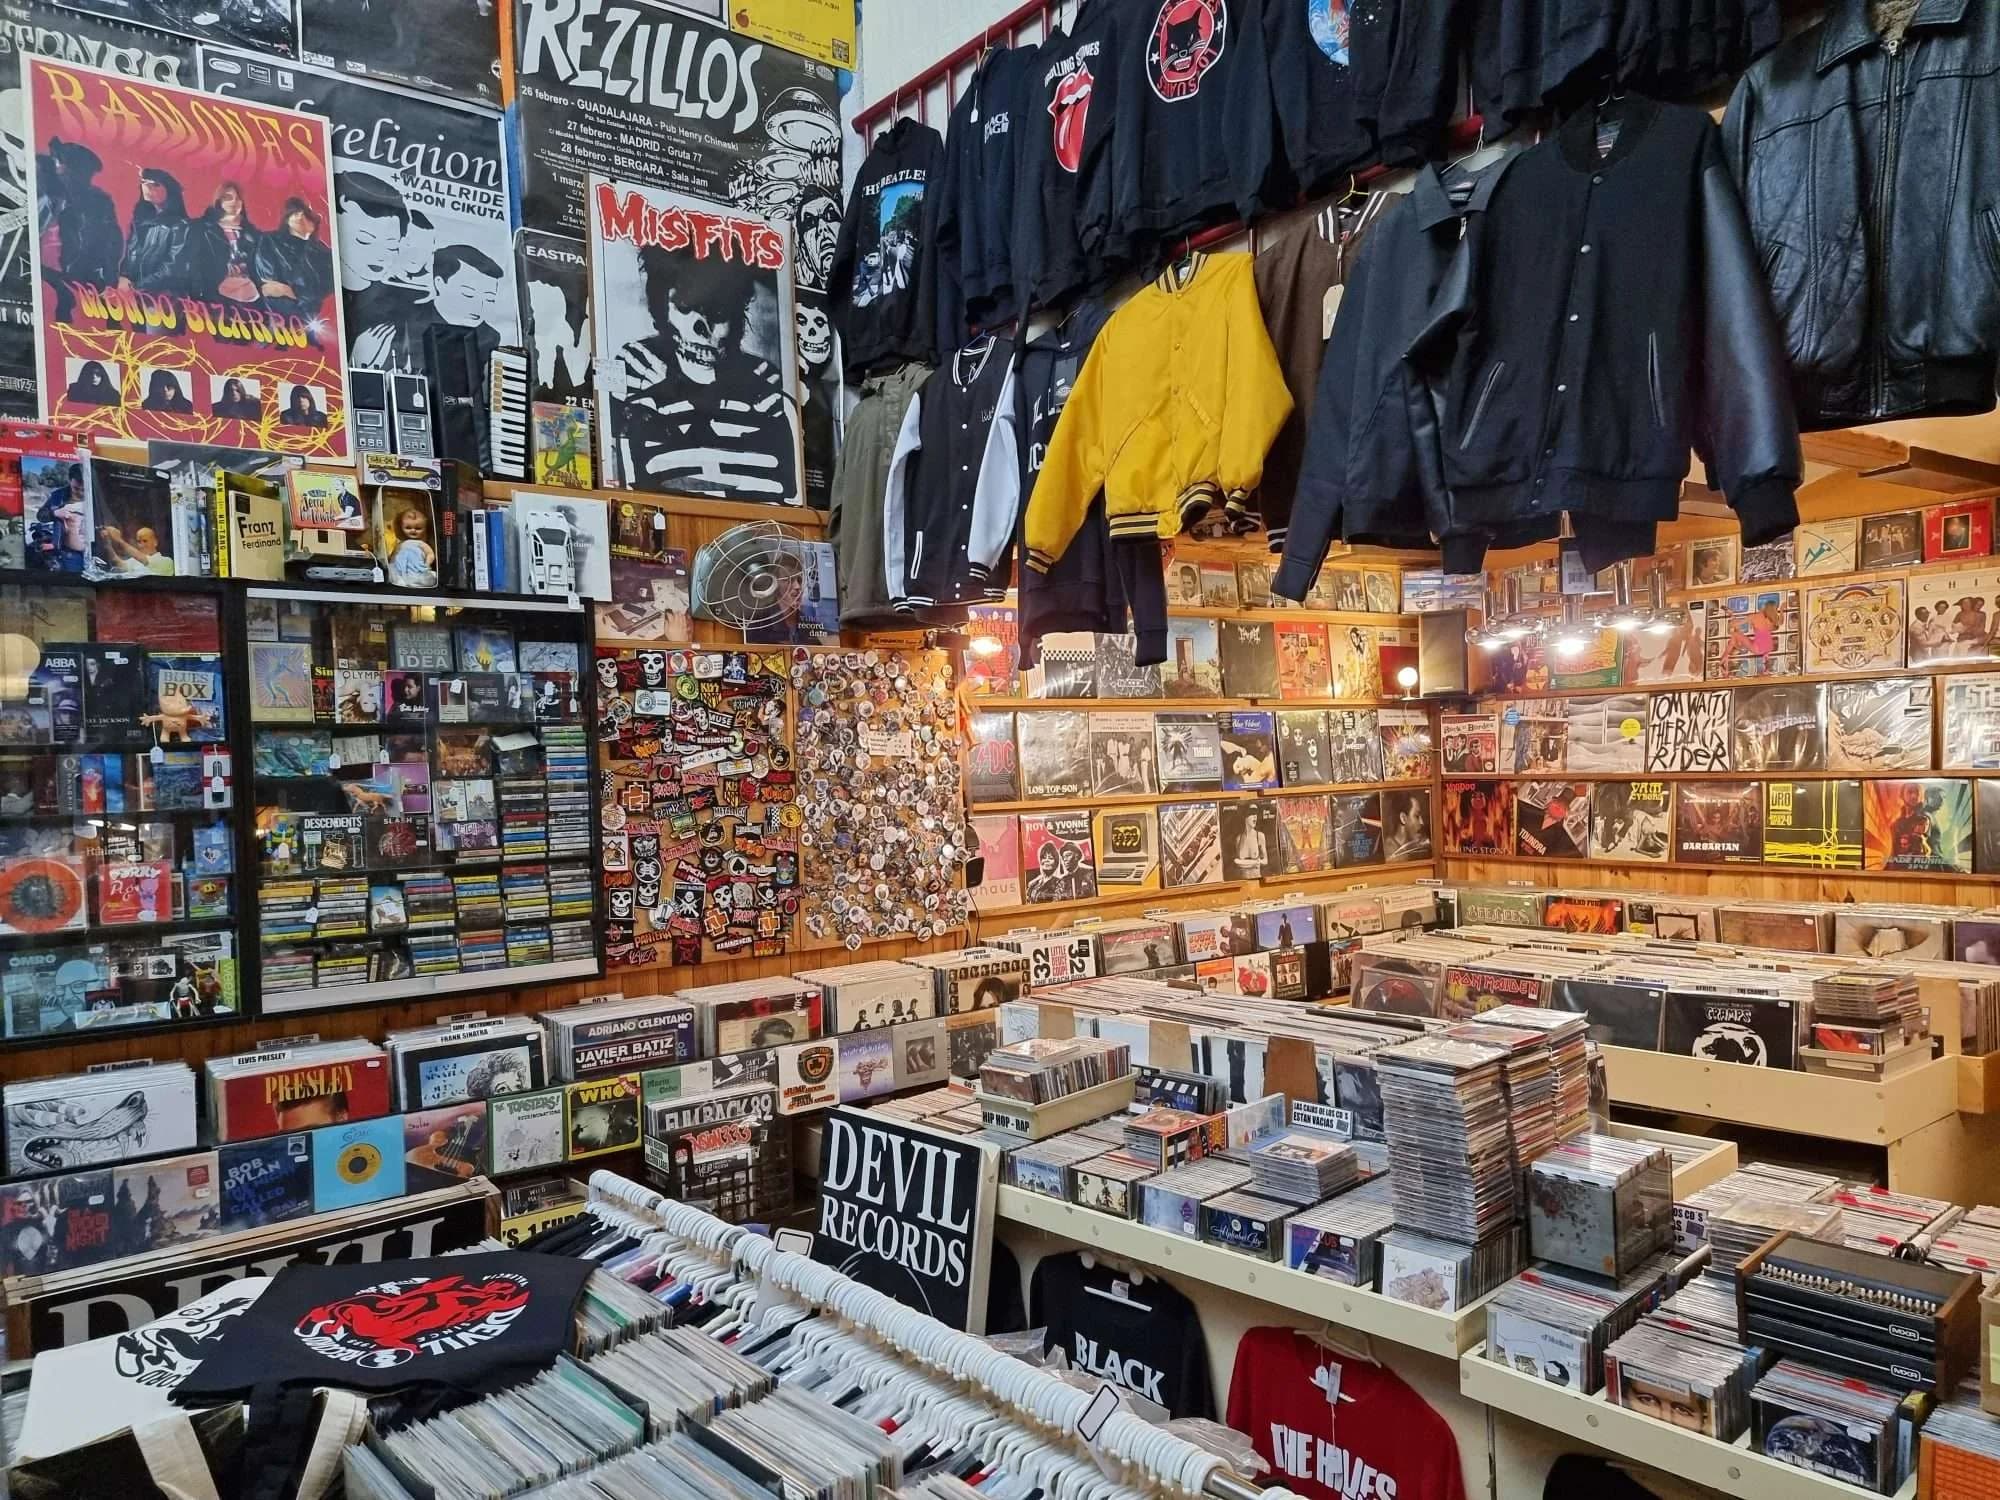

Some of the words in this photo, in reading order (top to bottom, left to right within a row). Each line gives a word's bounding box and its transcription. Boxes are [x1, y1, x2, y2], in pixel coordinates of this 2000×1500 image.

[522, 0, 763, 134] REZILLOS
[521, 85, 534, 96] 26
[535, 88, 569, 106] febrero
[576, 98, 653, 127] GUADALAJARA
[660, 121, 677, 134] Pub
[678, 125, 703, 144] Henry
[40, 66, 326, 185] RAMONES
[567, 120, 578, 131] 27
[579, 123, 612, 141] febrero
[619, 133, 661, 153] MADRID
[667, 146, 692, 161] Gruta
[692, 153, 703, 163] 77
[560, 142, 573, 154] 28
[574, 145, 607, 162] febrero
[614, 155, 665, 177] BERGARA
[671, 170, 690, 184] Sala
[690, 175, 709, 188] Jam
[450, 201, 506, 222] CIKUTA
[595, 182, 785, 271] MISFITS
[525, 245, 586, 266] EASTPA
[182, 297, 310, 349] BIZARRO
[238, 517, 276, 538] Franz
[242, 537, 282, 550] Ferdinand
[798, 622, 825, 630] record
[808, 629, 828, 638] date
[45, 657, 77, 668] ABBA
[400, 656, 449, 669] IDEA
[163, 682, 208, 699] BOX
[1650, 694, 1684, 720] TOM
[1687, 691, 1729, 719] WAITS
[709, 714, 733, 727] MUSE
[1650, 723, 1672, 746] THE
[1028, 785, 1044, 794] LOS
[304, 816, 363, 829] DESCENDENTS
[1026, 821, 1046, 832] ROY
[1055, 819, 1089, 830] YVONNE
[1682, 842, 1740, 852] BARBARIAN
[1465, 904, 1496, 923] BEE
[1497, 906, 1530, 925] GEES
[1447, 969, 1482, 991] IRON
[1483, 969, 1541, 995] MAIDEN
[587, 1021, 636, 1038] ADRIANO
[637, 1012, 693, 1031] CELENTANO
[1706, 1008, 1752, 1023] CRAMPS
[440, 1034, 461, 1043] FRANK
[461, 1028, 489, 1039] SINATRA
[237, 1056, 257, 1065] ELVIS
[257, 1052, 286, 1063] PRESLEY
[576, 1044, 630, 1065] JAVIER
[632, 1036, 675, 1053] BATIZ
[581, 1060, 597, 1069] and
[600, 1057, 614, 1066] The
[264, 1064, 354, 1105] PRESLEY
[579, 1084, 626, 1104] WHO
[982, 1111, 995, 1124] HIP
[995, 1114, 1011, 1128] HOP
[1015, 1118, 1030, 1132] RAP
[1318, 1106, 1326, 1115] DE
[1326, 1108, 1336, 1117] LOS
[223, 1161, 281, 1192] DYLAN
[228, 1156, 263, 1178] BOB
[822, 1116, 971, 1235] DEVIL
[527, 1224, 538, 1239] 1
[819, 1194, 966, 1288] RECORDS
[419, 1304, 527, 1356] DEVIL
[1891, 1327, 1917, 1340] MXR
[1075, 1331, 1165, 1402] BLACK
[1892, 1367, 1919, 1380] MXR
[1270, 1421, 1313, 1480] THE
